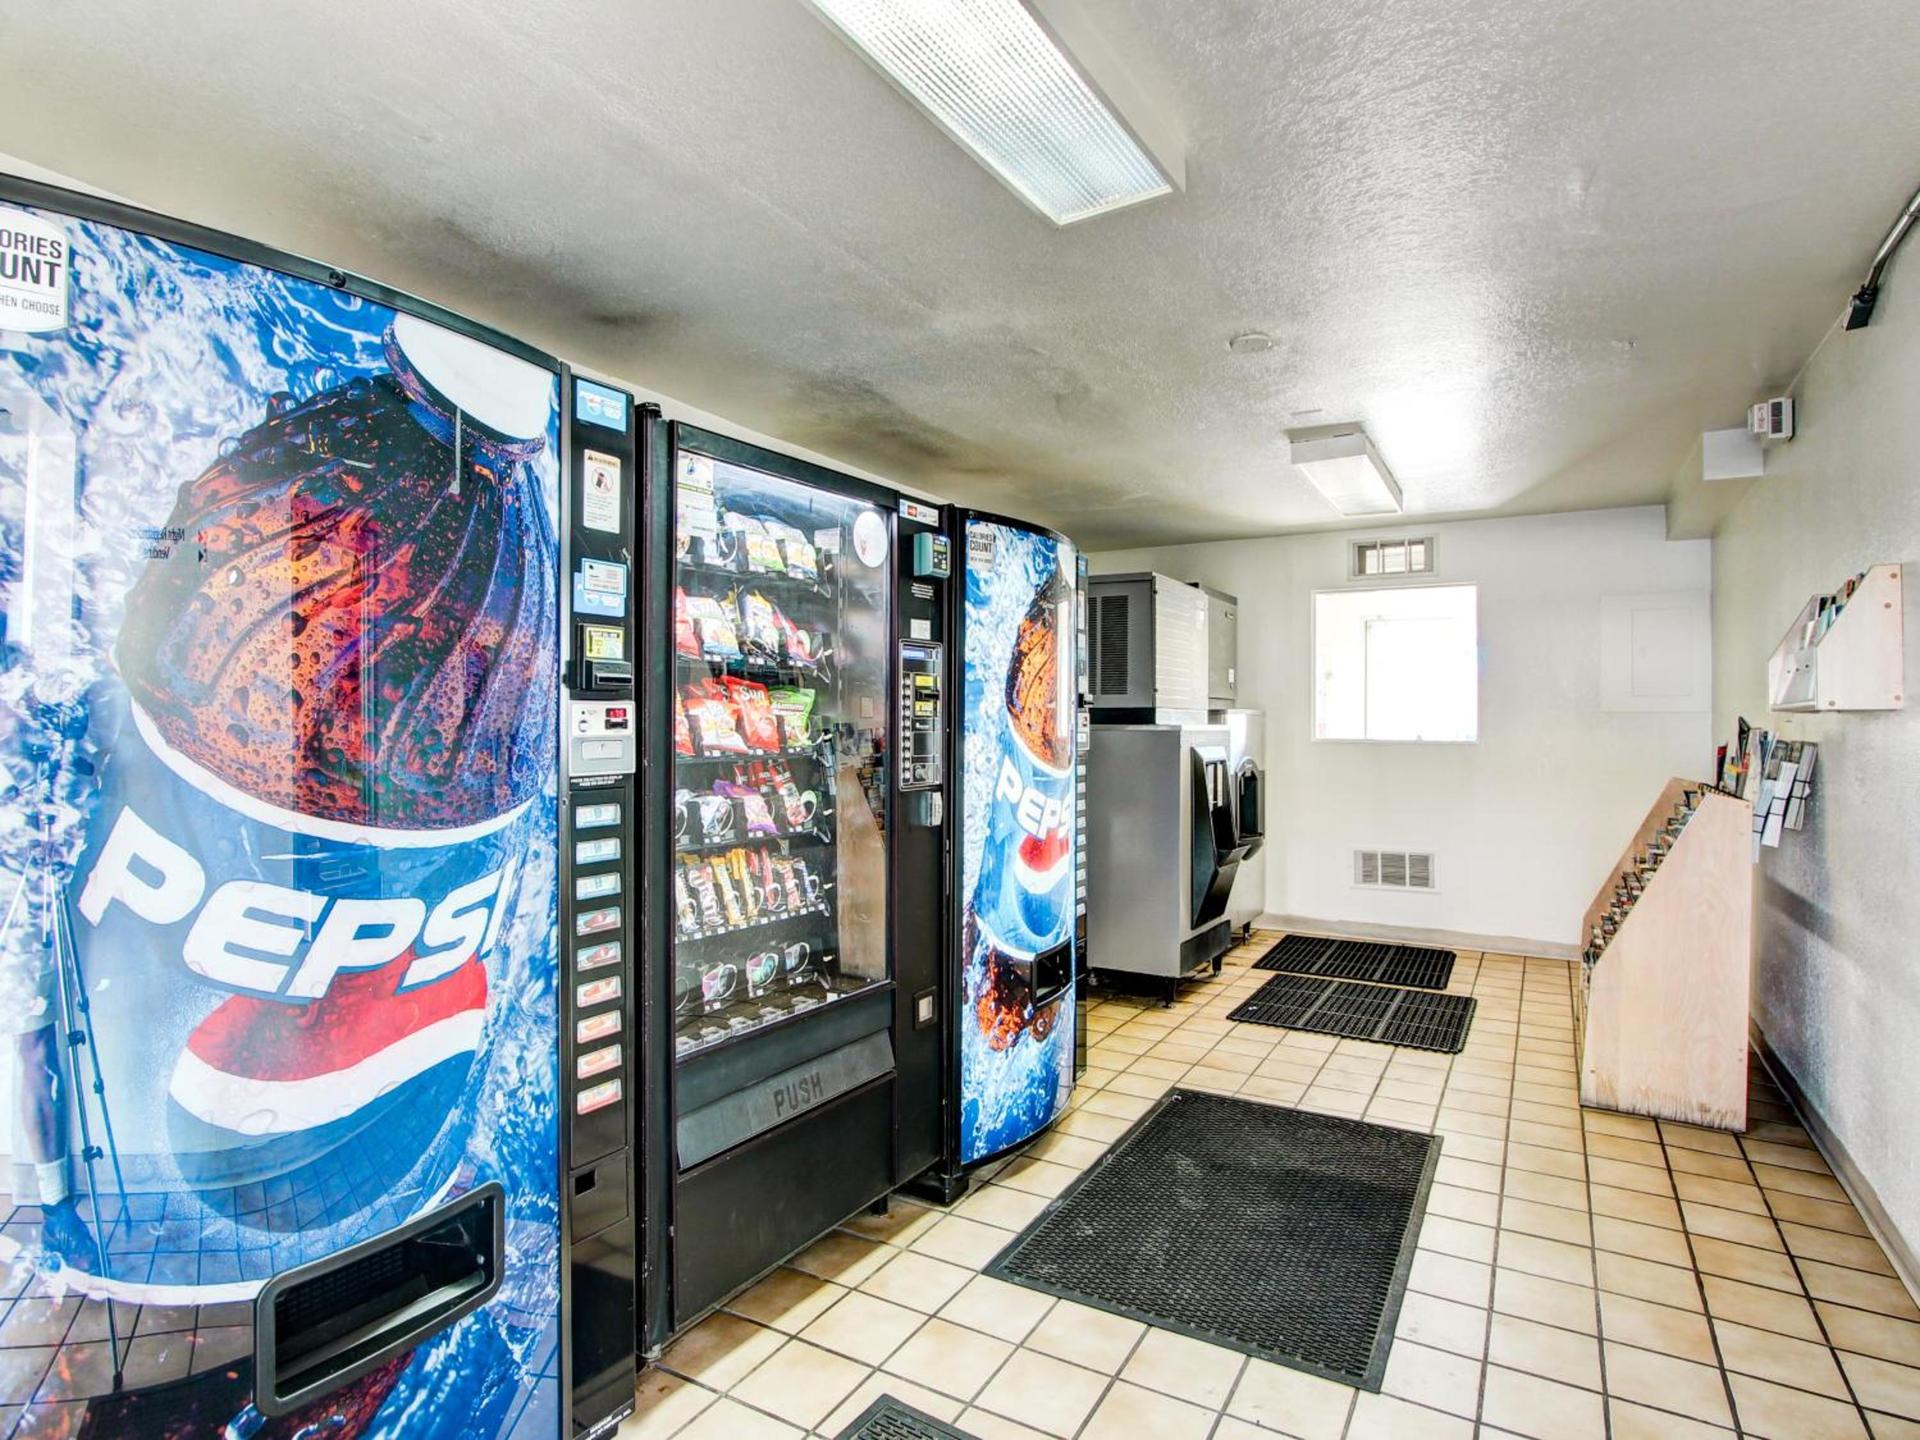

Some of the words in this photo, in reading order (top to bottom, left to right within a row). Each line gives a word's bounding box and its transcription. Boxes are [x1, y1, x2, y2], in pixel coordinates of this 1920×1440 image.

[0, 228, 62, 259] ORIES
[0, 253, 62, 288] UNT
[21, 298, 61, 316] CHOOSE
[969, 539, 993, 553] COUNT
[739, 685, 765, 701] Sun
[79, 805, 517, 999] PEPSI
[773, 1072, 824, 1117] PUSH
